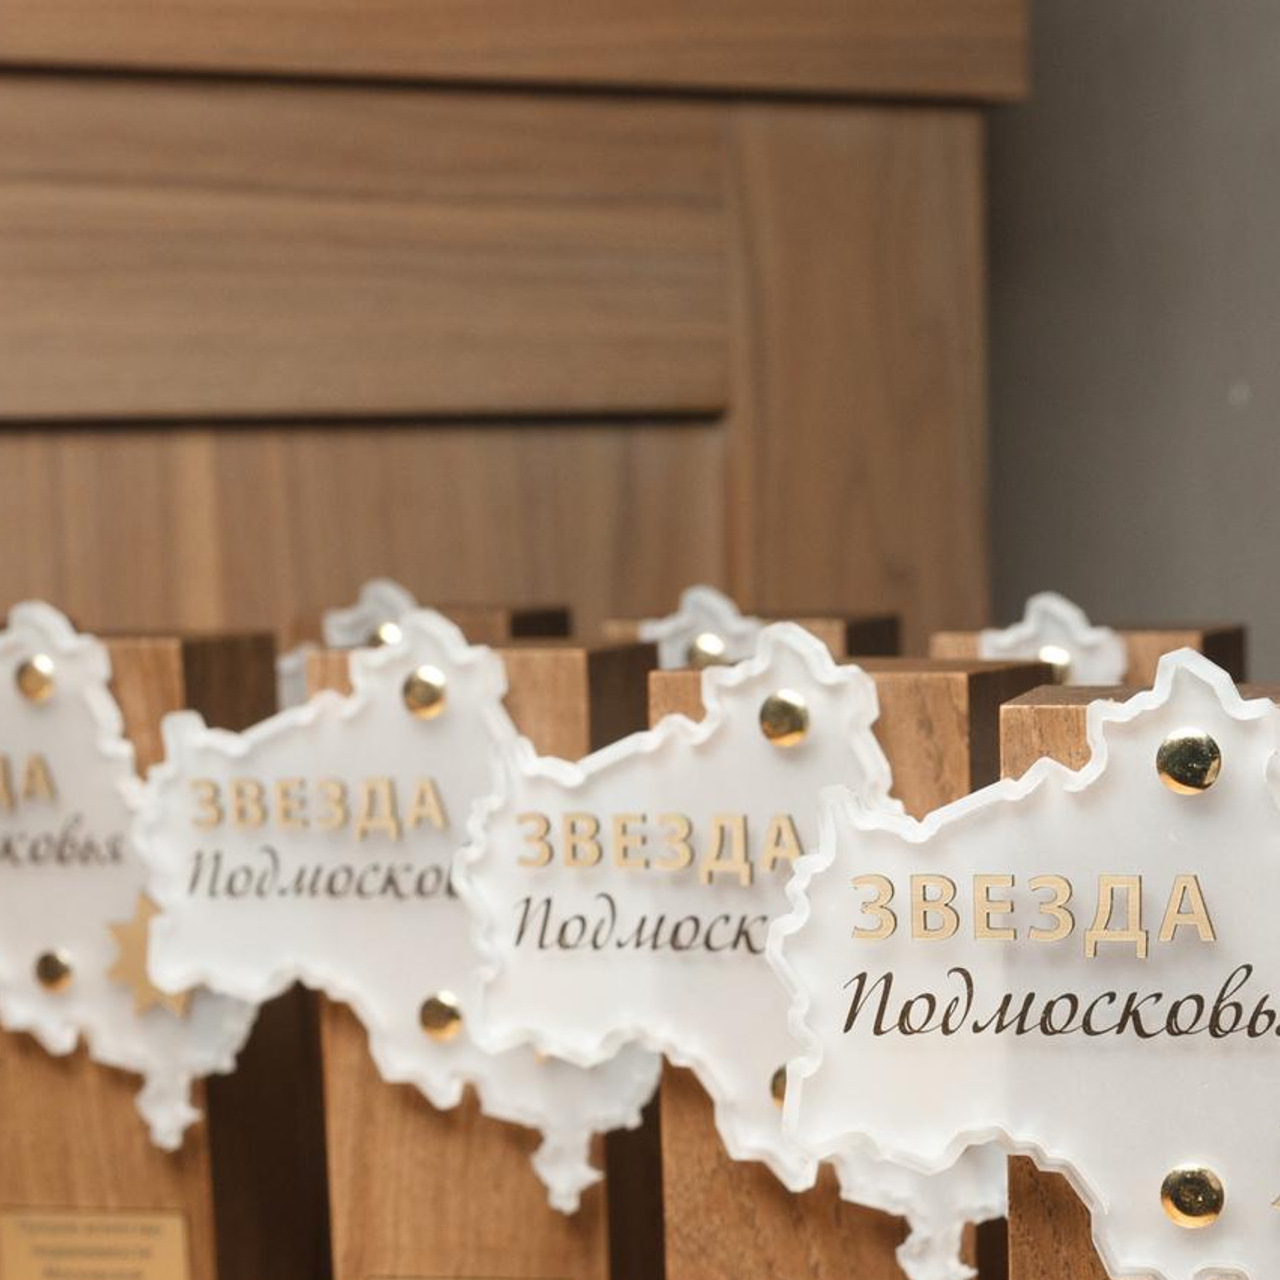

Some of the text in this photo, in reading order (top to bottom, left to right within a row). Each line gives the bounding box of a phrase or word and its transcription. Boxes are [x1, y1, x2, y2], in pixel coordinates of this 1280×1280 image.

[189, 776, 449, 842] ЗВЕЗДА
[515, 811, 804, 887] ЗВЕЗДА
[851, 873, 1216, 959] ЗВЕЗДА
